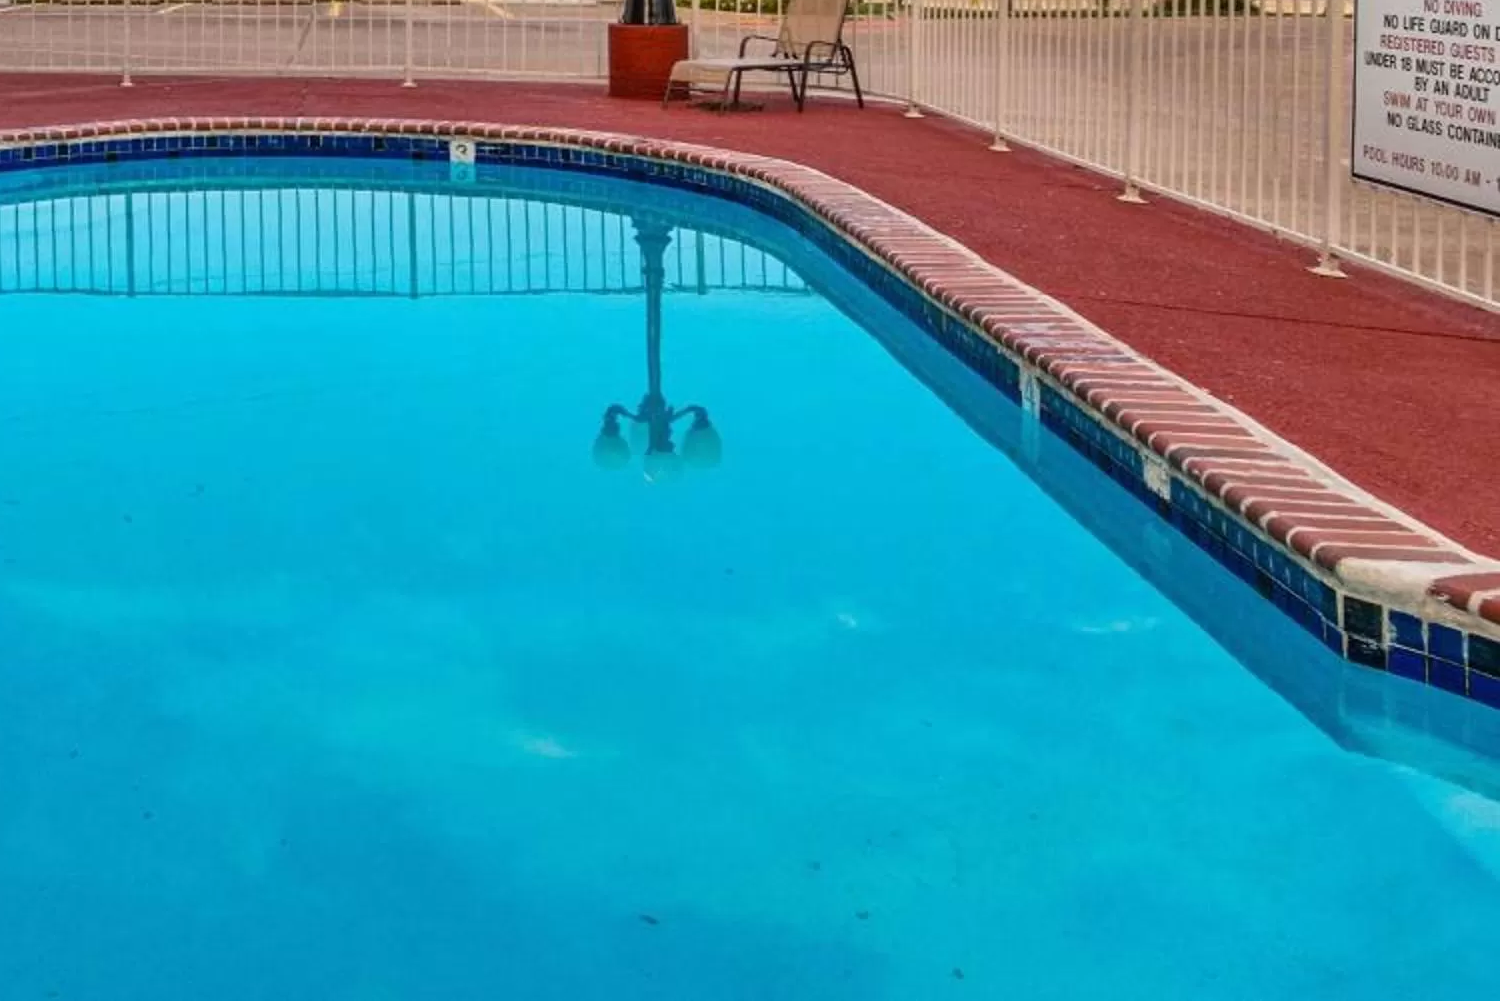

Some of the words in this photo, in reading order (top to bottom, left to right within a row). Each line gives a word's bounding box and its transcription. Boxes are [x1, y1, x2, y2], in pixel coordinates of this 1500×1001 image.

[1443, 0, 1482, 18] DIVING
[1383, 14, 1399, 30] NO
[1403, 16, 1425, 32] LIFE
[1430, 18, 1468, 38] GUARD
[1473, 23, 1490, 40] ON
[1380, 34, 1445, 56] REGISTERED
[1451, 42, 1495, 63] GUESTS
[1364, 51, 1397, 69] UNDER
[1401, 56, 1412, 72] 18
[1415, 58, 1445, 76] MUST
[1450, 64, 1464, 80] BE
[1414, 76, 1429, 92] BY
[1433, 80, 1449, 96] AN
[1454, 83, 1490, 103] ADULT
[1383, 90, 1411, 109] SWIM
[1415, 96, 1428, 112] AT
[1434, 100, 1463, 120] YOUR
[1468, 106, 1496, 125] OWN
[1387, 111, 1402, 128] NO
[1406, 116, 1442, 136] GLASS
[1363, 144, 1388, 164] POOL
[1392, 151, 1425, 173] HOURS
[1465, 168, 1481, 186] AM
